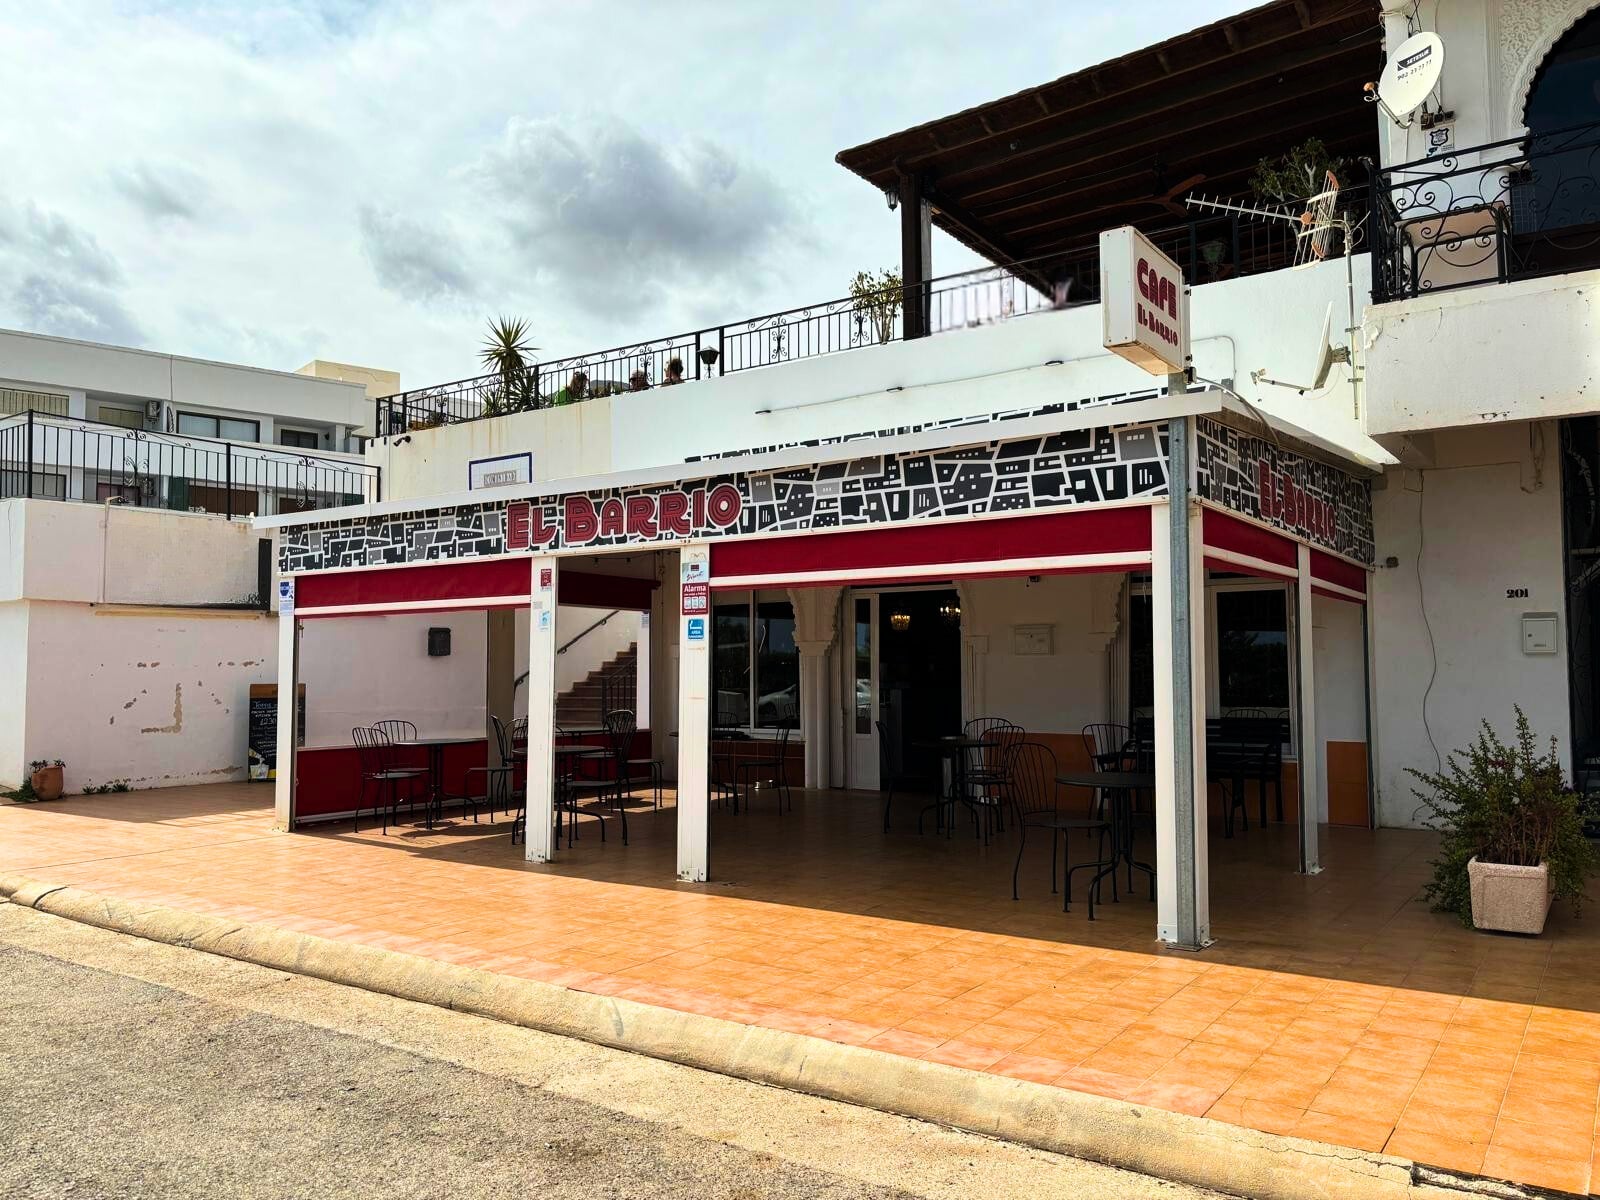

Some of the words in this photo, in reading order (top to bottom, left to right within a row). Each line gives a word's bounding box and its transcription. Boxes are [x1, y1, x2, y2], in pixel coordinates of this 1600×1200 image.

[1137, 257, 1177, 321] CAFE
[1137, 302, 1149, 327] EL
[1148, 310, 1178, 346] BARRIO
[506, 501, 557, 550] EL
[563, 484, 742, 544] BARRIO
[1259, 459, 1283, 519] EL
[1283, 471, 1336, 543] BARRIO
[1506, 588, 1529, 599] 201
